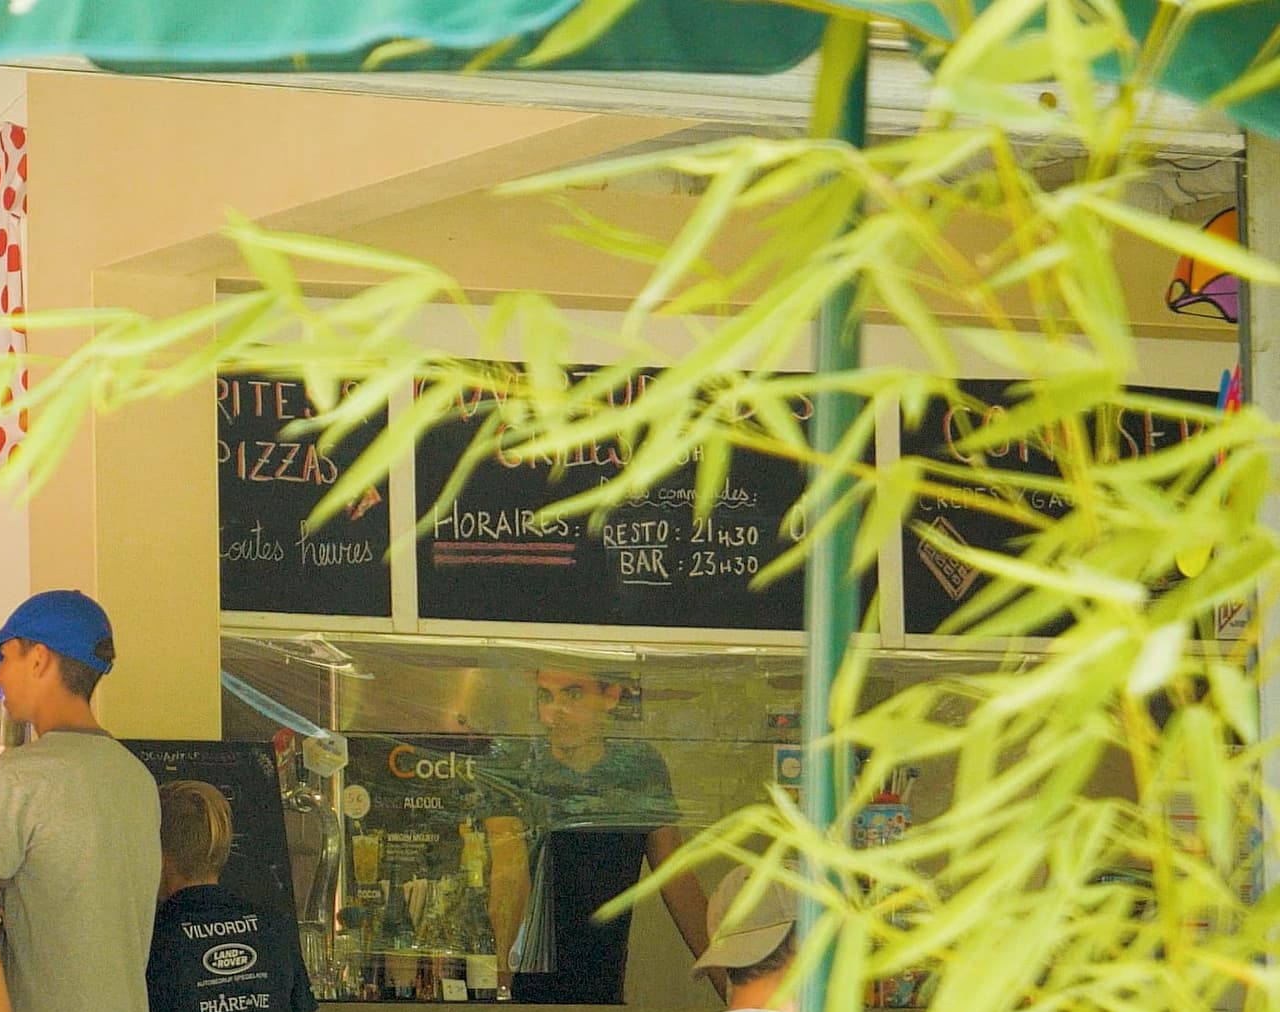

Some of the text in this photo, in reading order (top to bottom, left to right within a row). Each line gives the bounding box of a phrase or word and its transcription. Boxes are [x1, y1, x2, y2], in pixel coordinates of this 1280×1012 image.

[217, 378, 315, 419] RITE
[295, 519, 374, 567] heures
[603, 519, 669, 546] RESTO
[620, 548, 669, 579] BAR
[213, 949, 239, 960] LAND
[217, 956, 248, 969] ROVER
